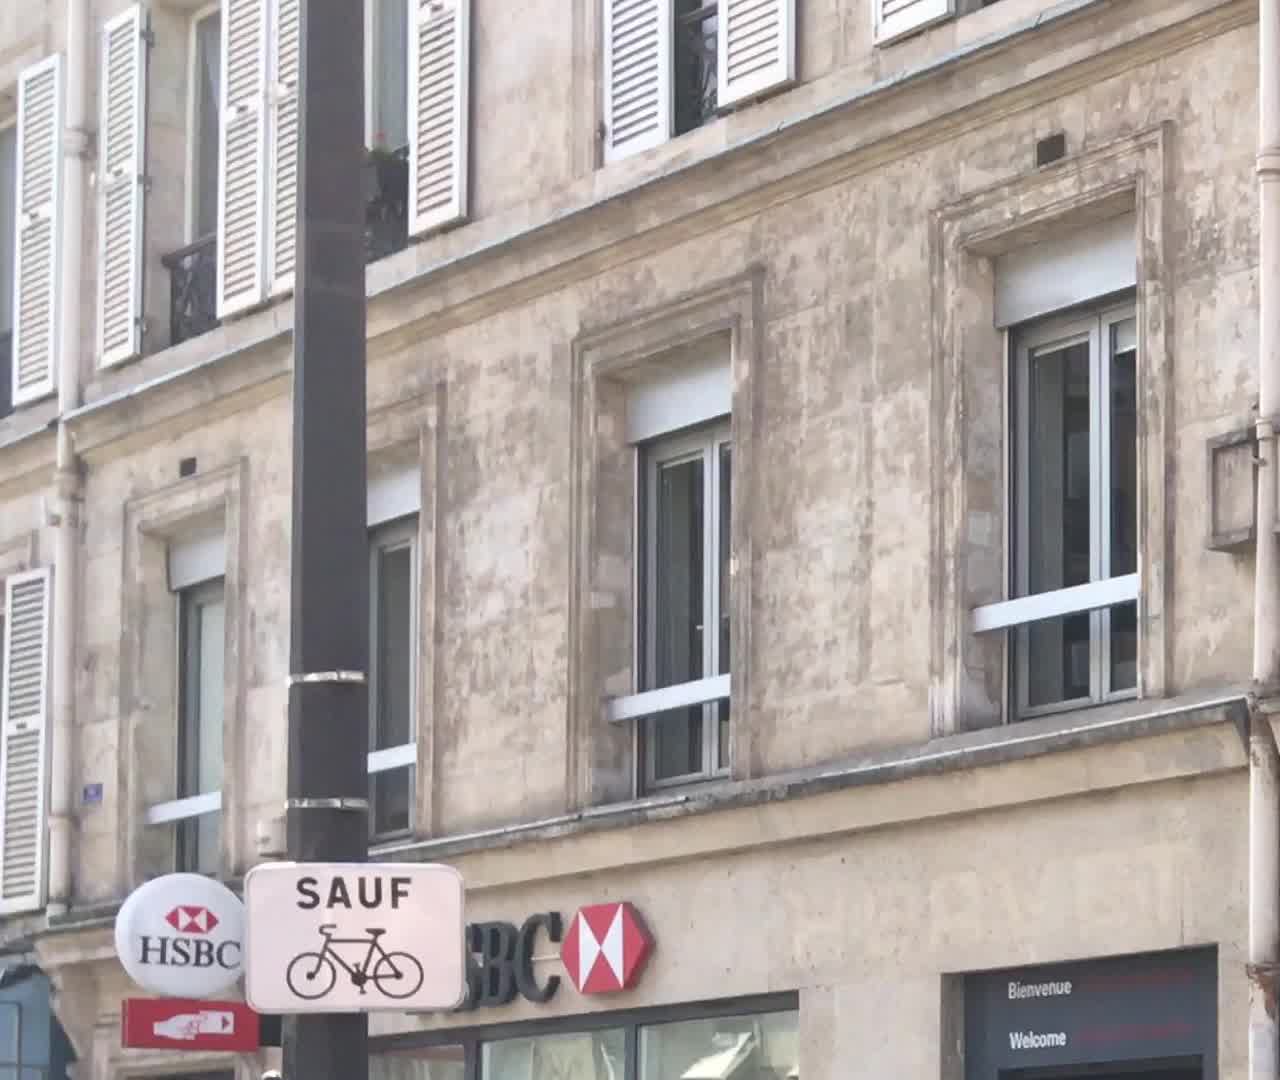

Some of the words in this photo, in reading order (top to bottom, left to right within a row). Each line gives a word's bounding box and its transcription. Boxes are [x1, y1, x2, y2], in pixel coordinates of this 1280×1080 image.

[297, 876, 411, 910] SAUF
[140, 936, 241, 970] HSBC
[1008, 981, 1072, 999] Bienvenue
[1009, 1031, 1066, 1049] Welcome
